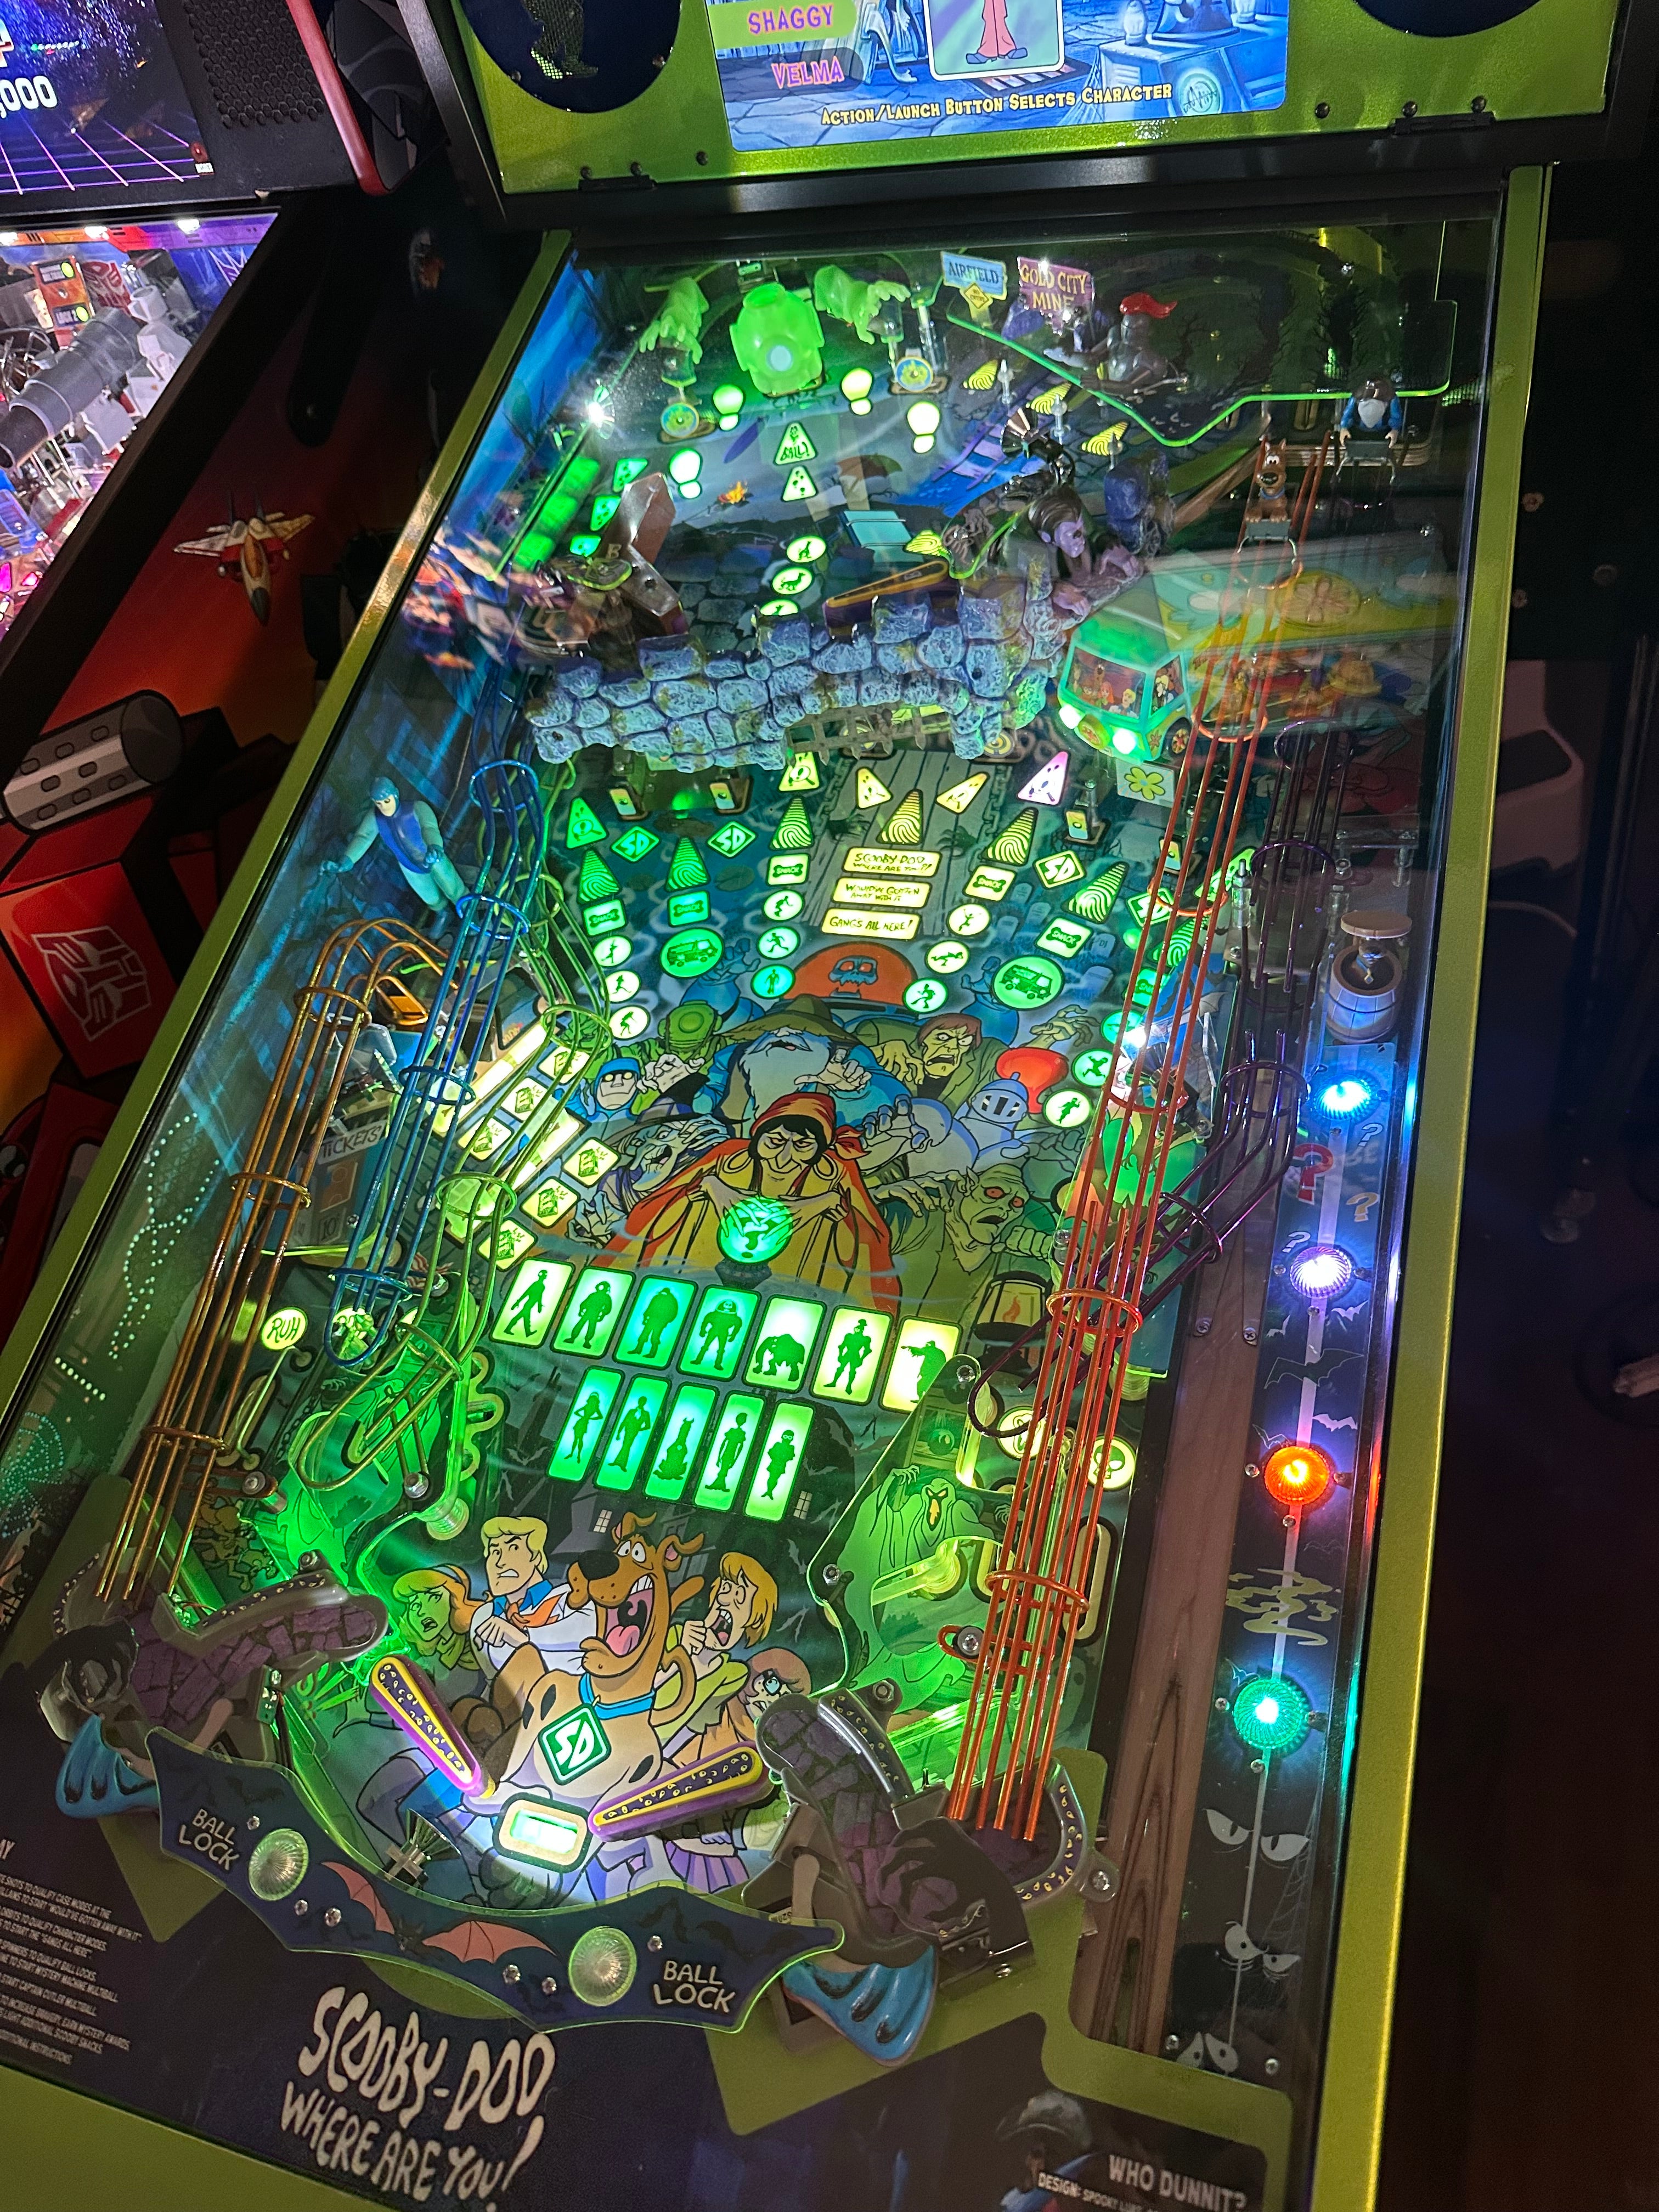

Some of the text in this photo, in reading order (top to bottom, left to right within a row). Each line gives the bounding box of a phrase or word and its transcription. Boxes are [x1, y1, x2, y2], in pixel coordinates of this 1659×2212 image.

[748, 4, 833, 36] SHAGGY
[771, 56, 844, 89] VELMA
[945, 97, 1003, 116] BUTTON
[1009, 92, 1076, 111] SELECTS
[1082, 83, 1172, 104] CHARACTER
[949, 262, 999, 284] AIRFIELD
[1020, 264, 1087, 295] GOLD CITY
[1032, 291, 1075, 311] MINE
[865, 921, 880, 930] ALL
[267, 1317, 300, 1343] RUH
[192, 1809, 235, 1845] BALL
[179, 1824, 240, 1870] LOCK
[664, 1960, 723, 1985] BALL
[653, 1984, 735, 2013] LOCK
[298, 1987, 556, 2131] SCOOBY-DOO
[281, 2081, 379, 2176] WHERE
[370, 2130, 441, 2202] ARE
[1109, 2154, 1248, 2212] WHO DUNNIT?
